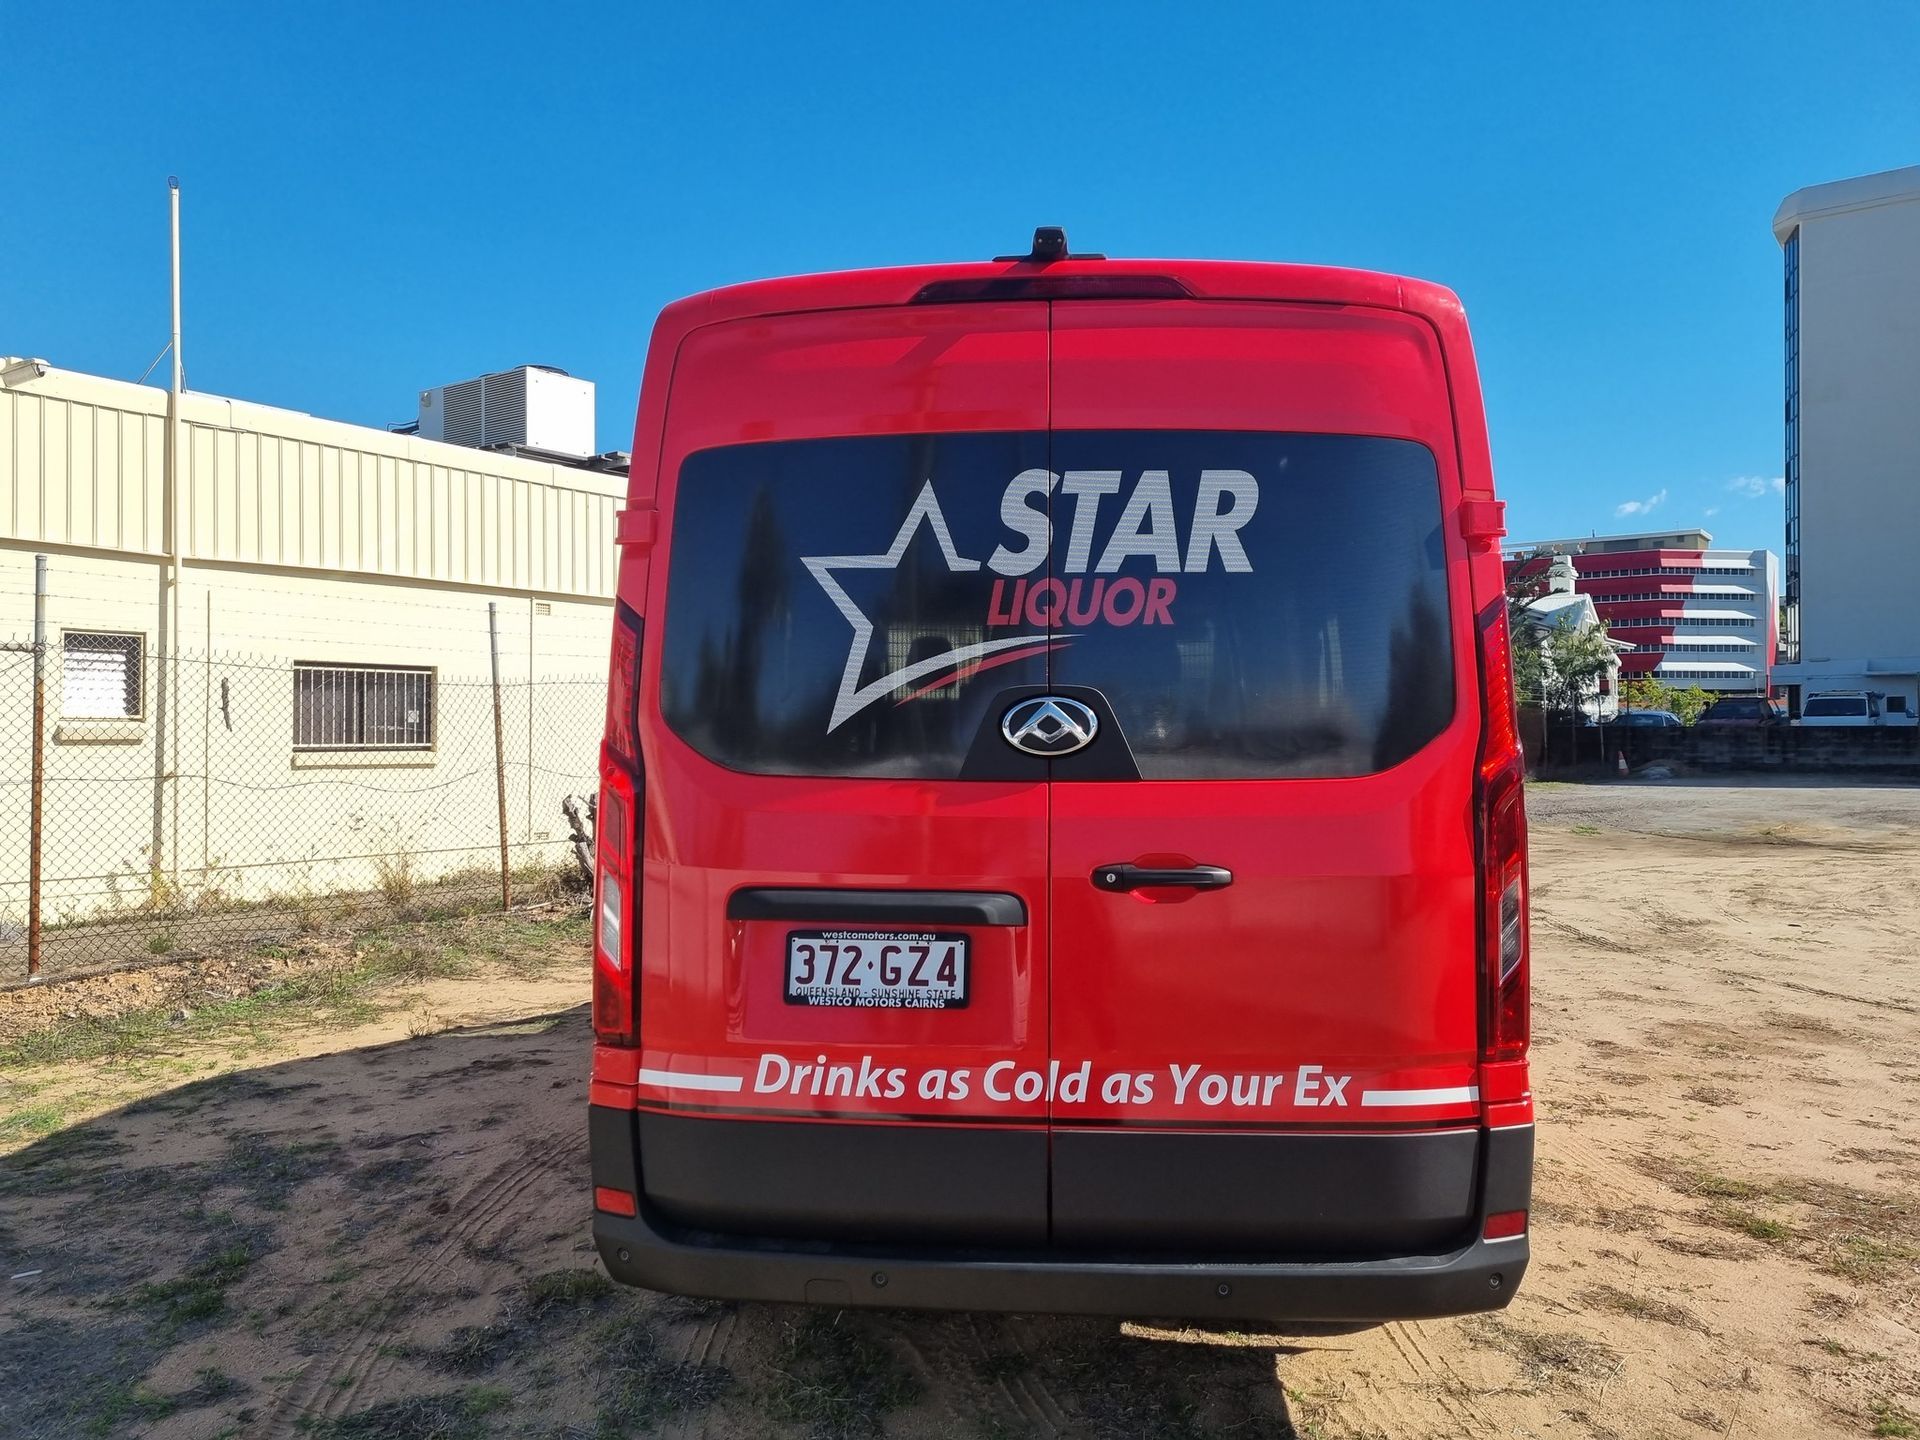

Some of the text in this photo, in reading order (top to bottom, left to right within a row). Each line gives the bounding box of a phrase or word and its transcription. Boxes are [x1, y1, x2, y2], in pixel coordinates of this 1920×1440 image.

[986, 468, 1260, 576] STAR
[986, 577, 1177, 627] LIQUOR
[822, 930, 936, 941] westcomotors.com.au
[795, 987, 861, 998] QUEENSLAND
[871, 988, 921, 999] SUNSHINE
[926, 989, 956, 999] STATE
[808, 996, 945, 1009] WESTCO MOTORS CAIRNS
[753, 1053, 1352, 1107] Drinks as Cold as Your Ex
